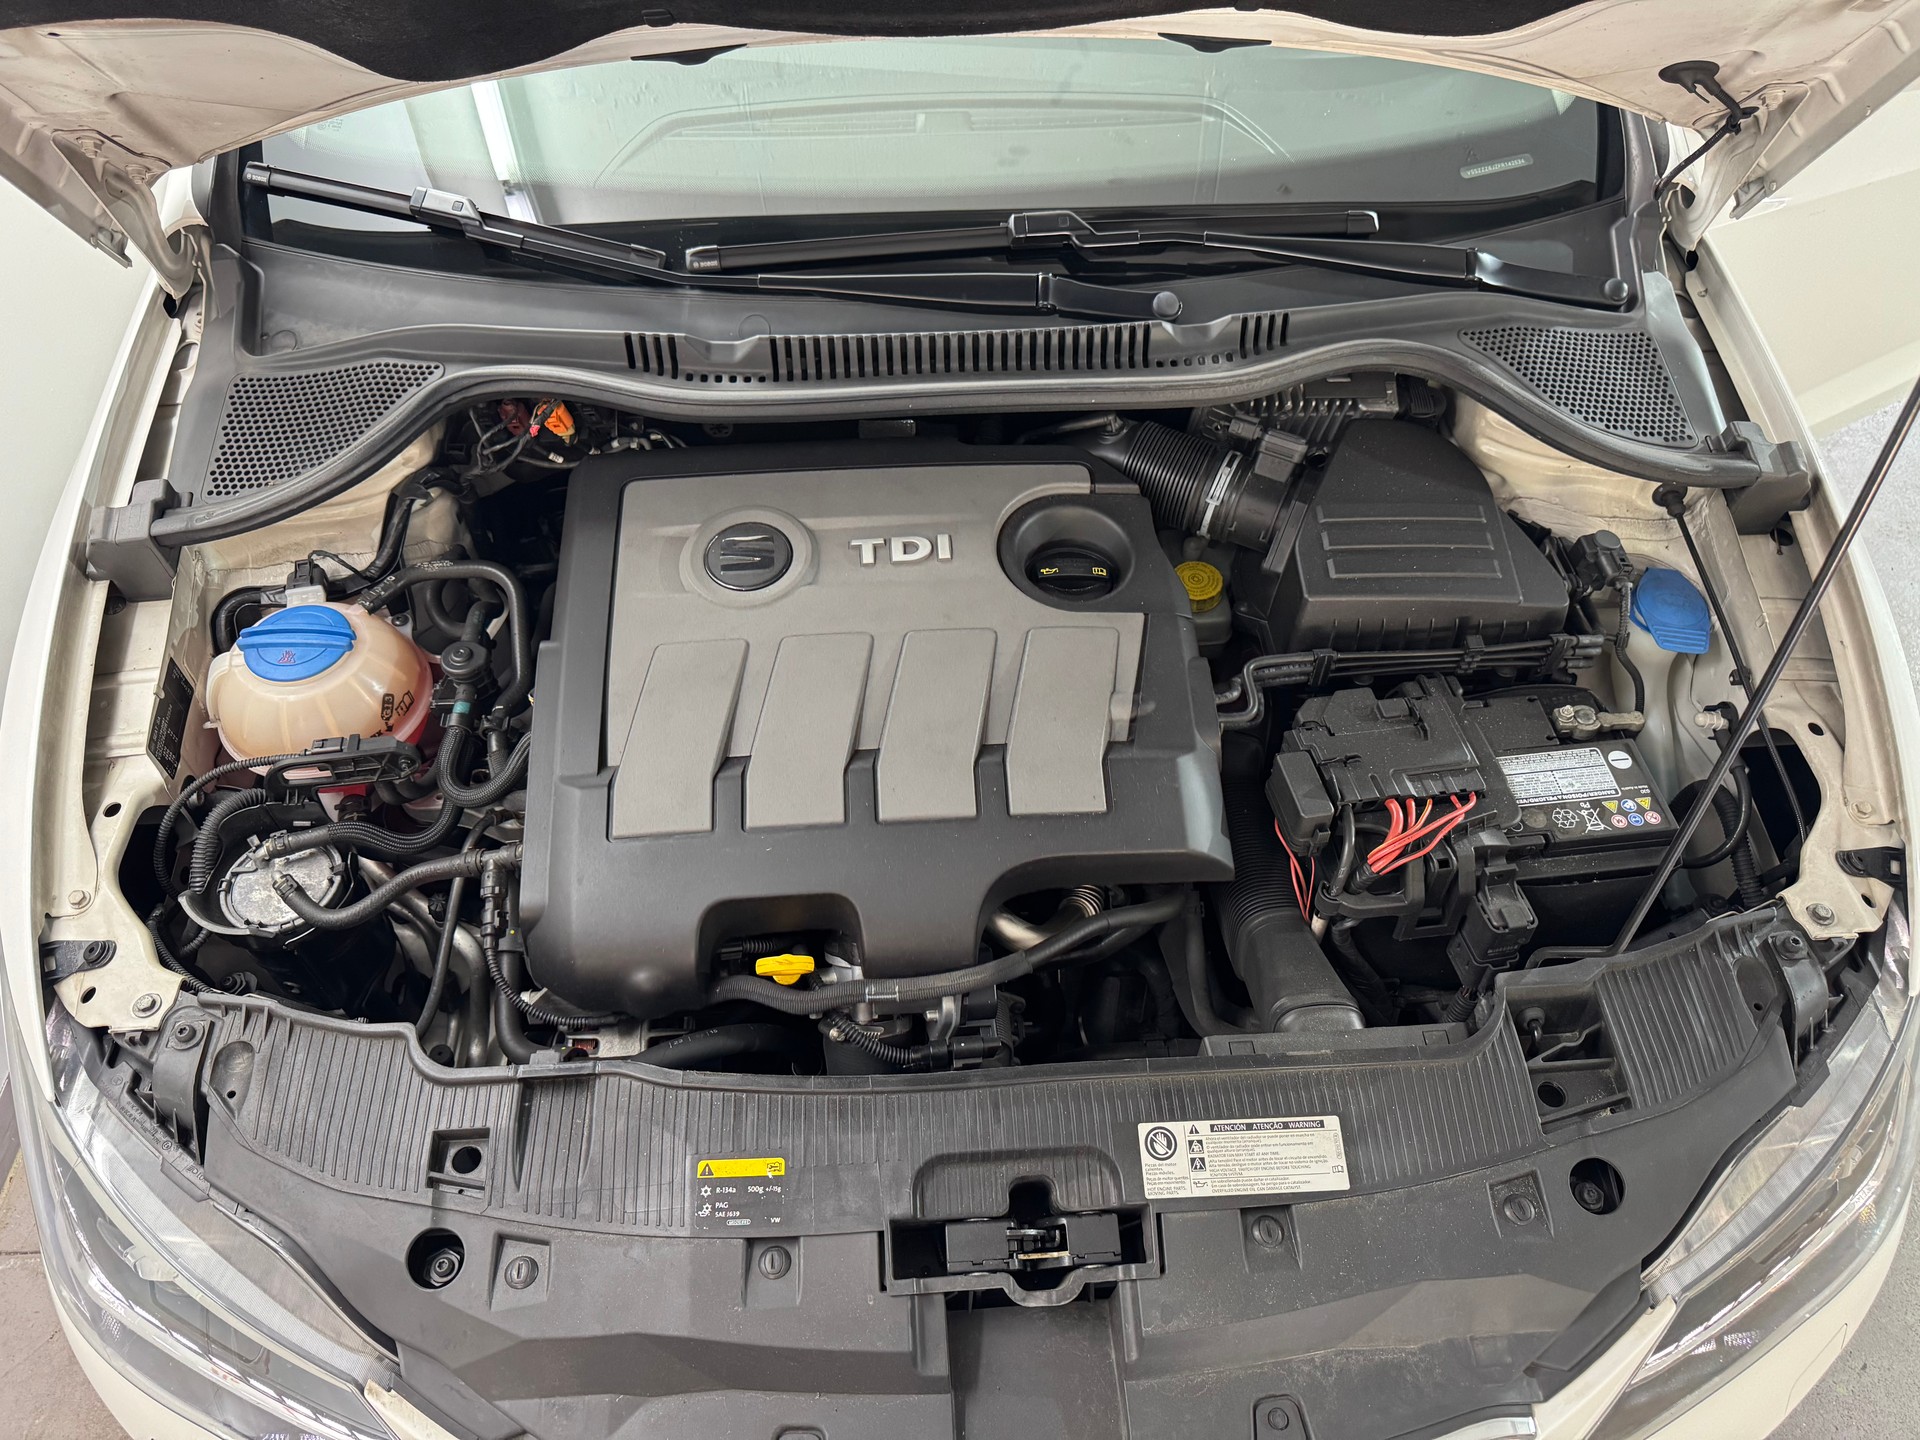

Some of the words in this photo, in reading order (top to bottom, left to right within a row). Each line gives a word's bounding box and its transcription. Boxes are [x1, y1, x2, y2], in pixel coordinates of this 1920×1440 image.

[848, 534, 953, 566] TDI
[1214, 1123, 1246, 1131] ATENCIÓN
[1252, 1122, 1283, 1130] ATENÇÃO
[1288, 1120, 1320, 1128] WARNING
[748, 1186, 764, 1194] 500g
